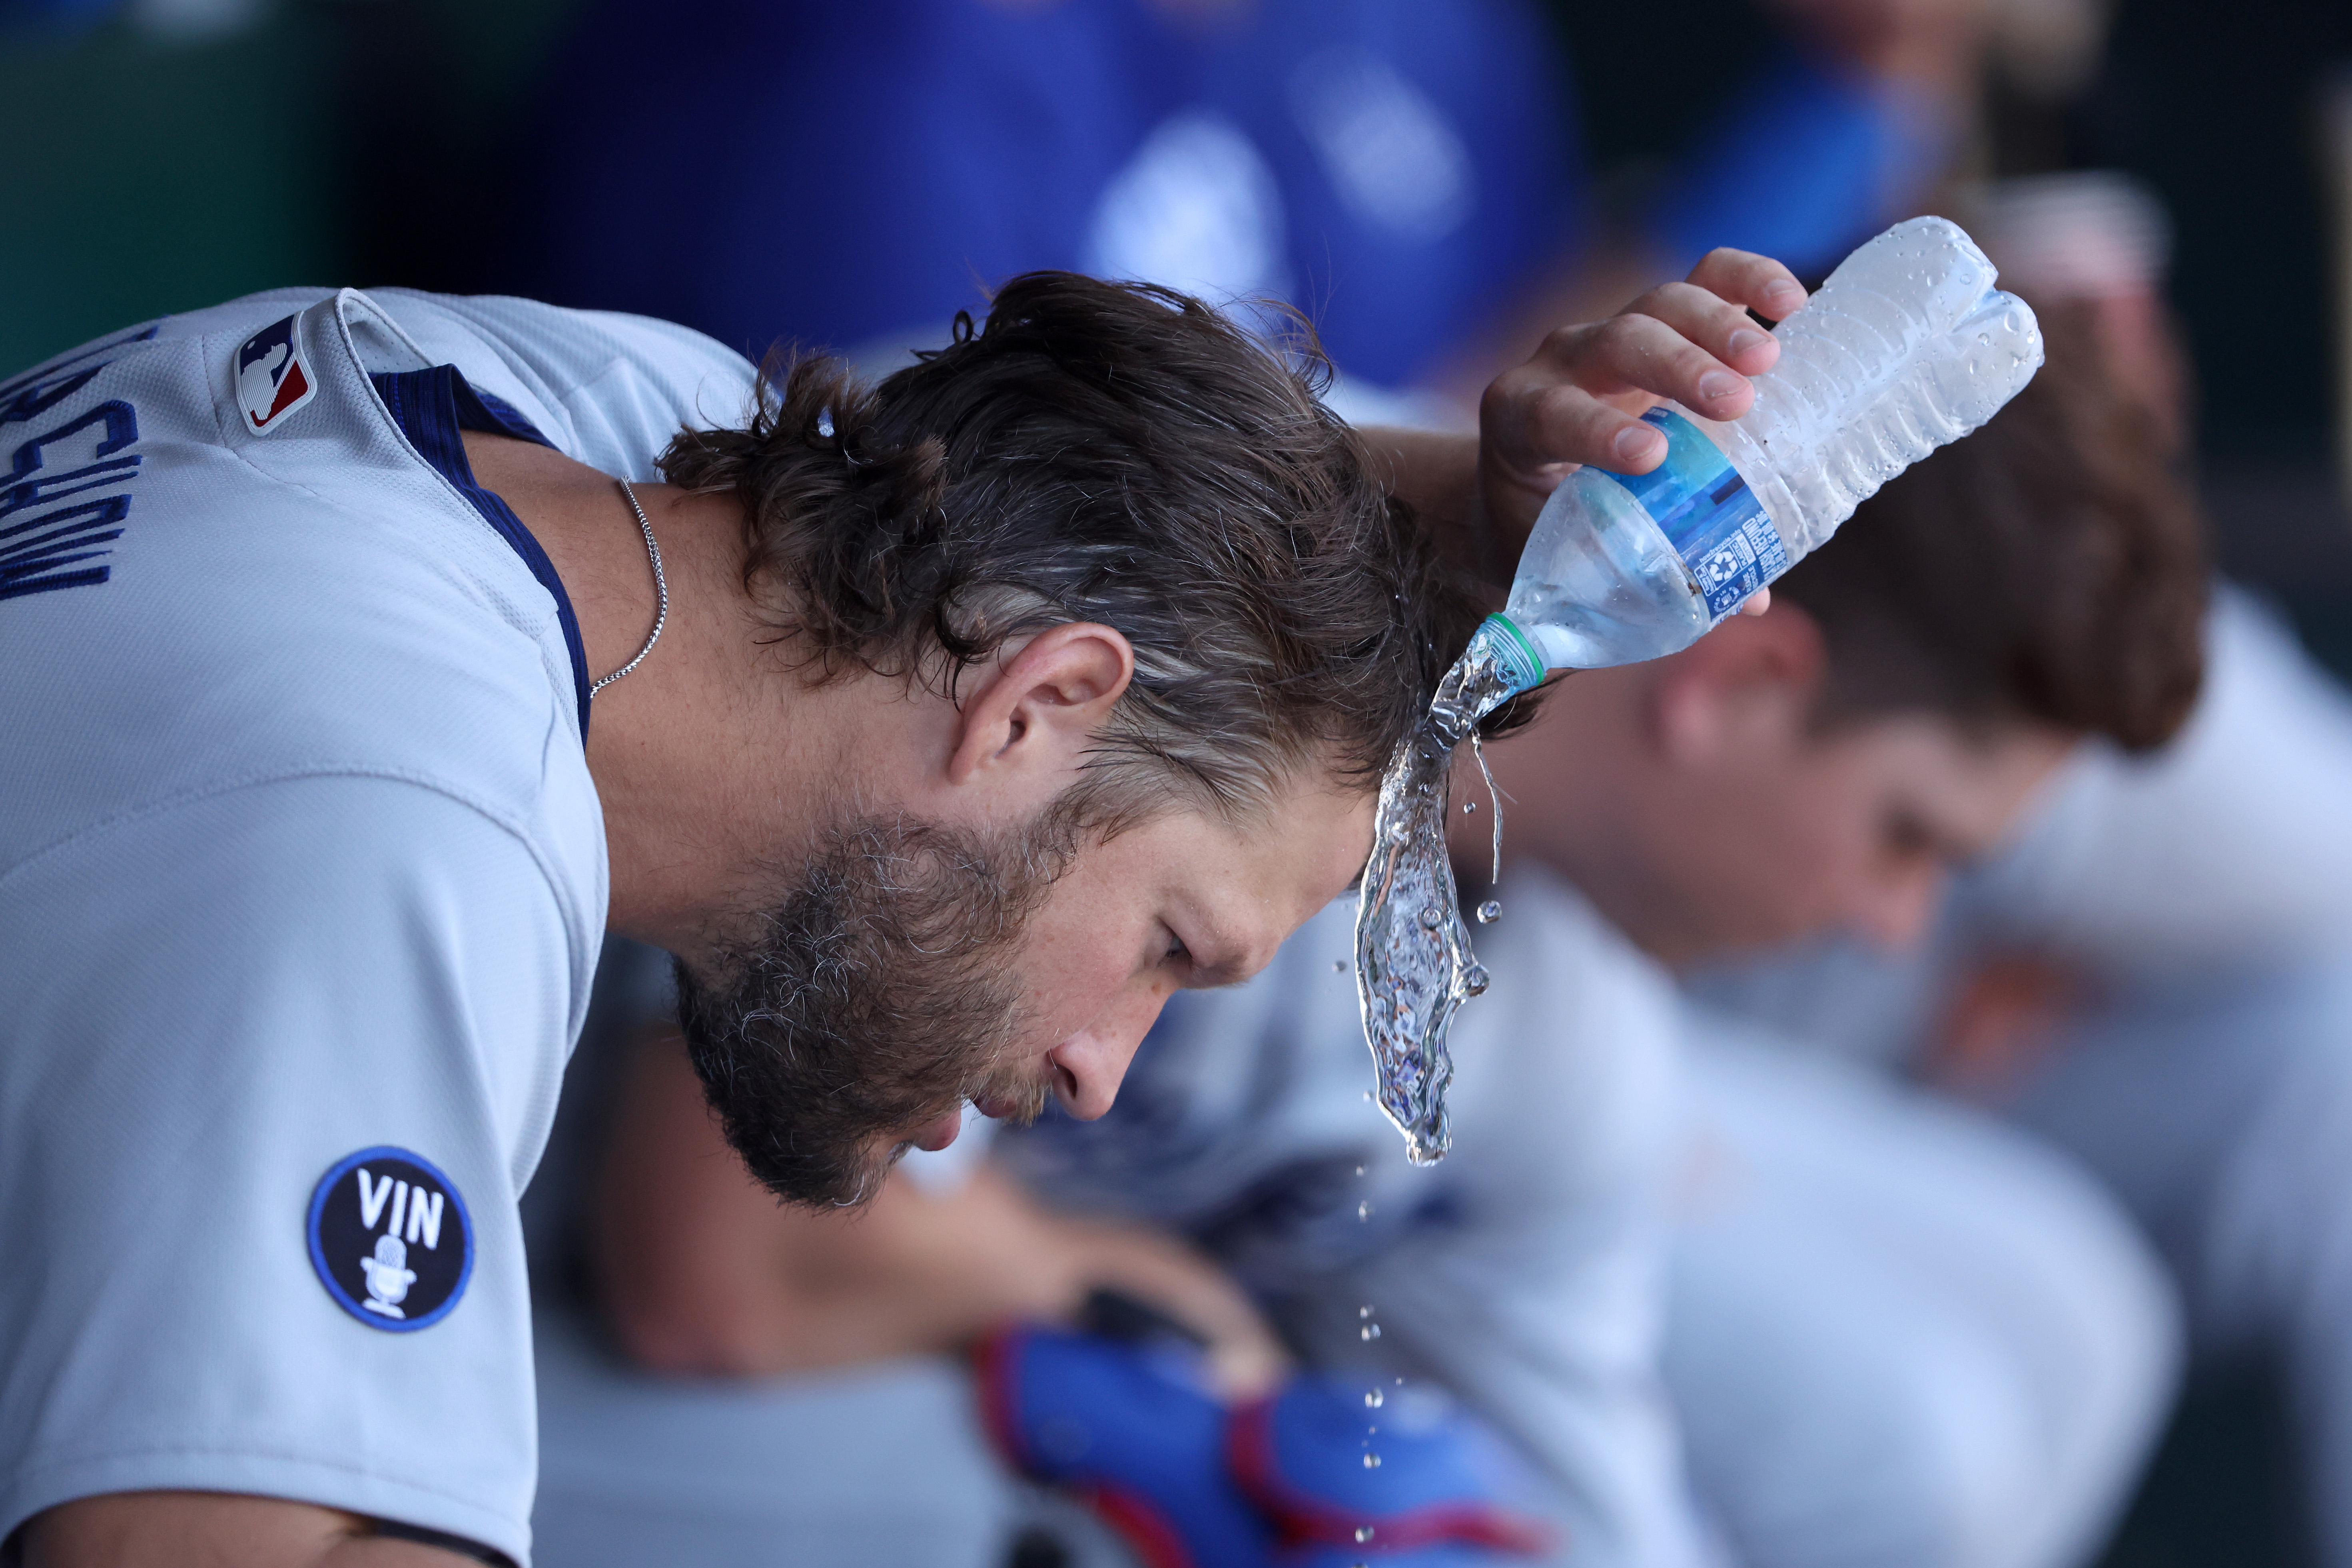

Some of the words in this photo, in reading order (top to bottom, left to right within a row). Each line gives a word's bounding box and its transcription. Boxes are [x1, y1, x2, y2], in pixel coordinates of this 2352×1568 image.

[1739, 538, 1753, 560] BOTTLE
[1742, 517, 1770, 556] REFUND
[1732, 541, 1748, 566] PLASTIC
[357, 1168, 445, 1250] VIN
